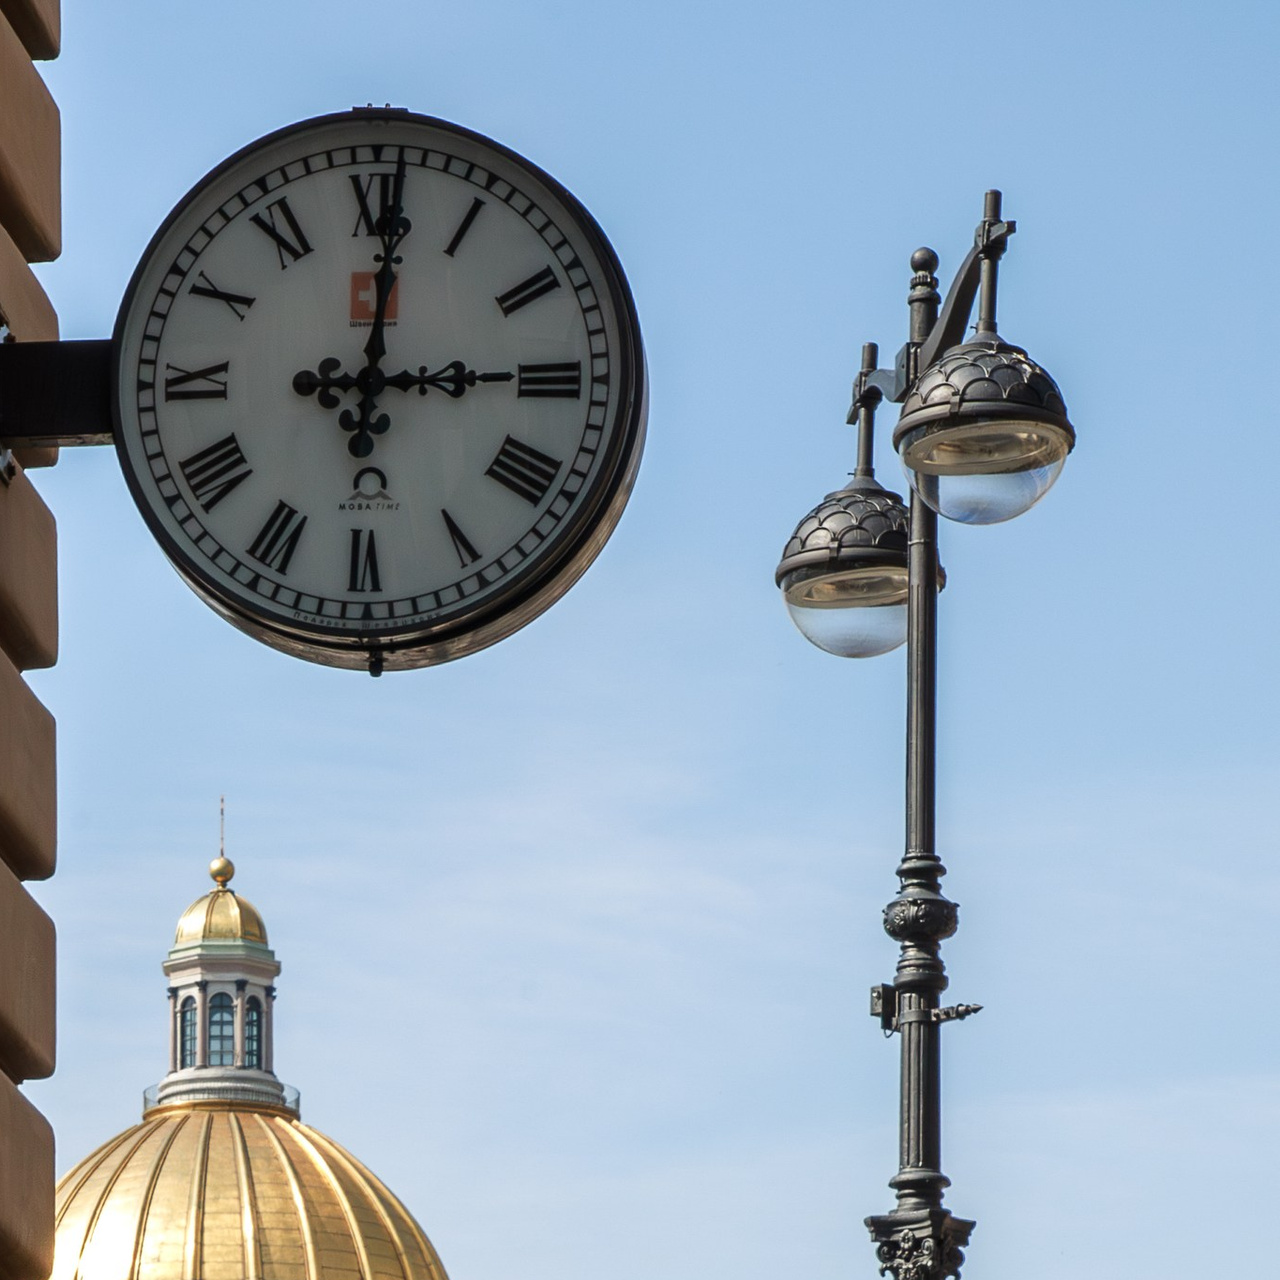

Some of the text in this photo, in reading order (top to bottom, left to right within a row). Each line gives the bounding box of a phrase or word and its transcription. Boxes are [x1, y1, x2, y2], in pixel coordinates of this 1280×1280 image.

[250, 196, 313, 269] XI
[444, 198, 486, 256] I
[189, 271, 255, 320] X
[495, 265, 561, 317] II
[165, 361, 229, 401] IX
[519, 362, 581, 399] III
[179, 433, 254, 513] VIII
[486, 435, 562, 507] IIII
[246, 500, 308, 575] VII
[348, 529, 381, 592] VI
[442, 509, 482, 567] V
